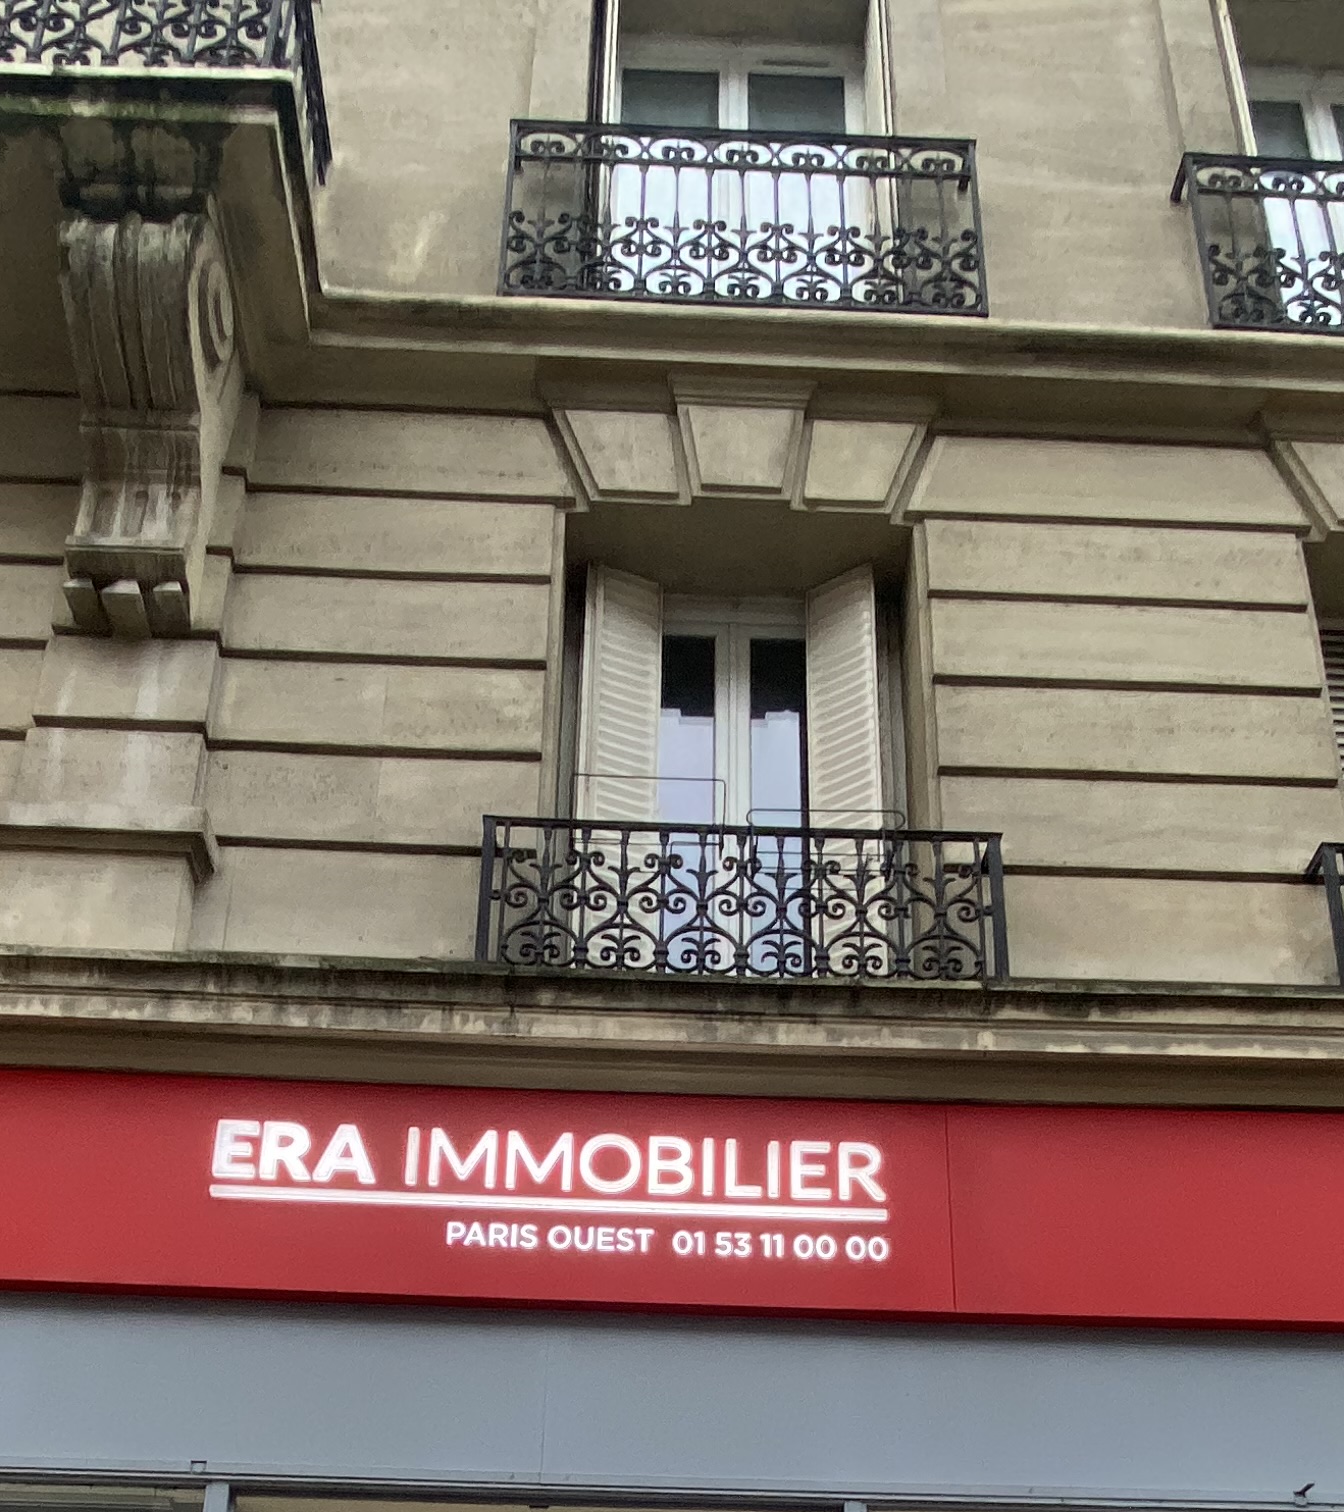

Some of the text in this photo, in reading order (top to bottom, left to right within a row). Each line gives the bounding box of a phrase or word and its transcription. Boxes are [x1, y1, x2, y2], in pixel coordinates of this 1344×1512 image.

[211, 1118, 887, 1203] ERA IMMOBILIER
[445, 1221, 890, 1262] PARIS OUEST 01 53 11 00 00
